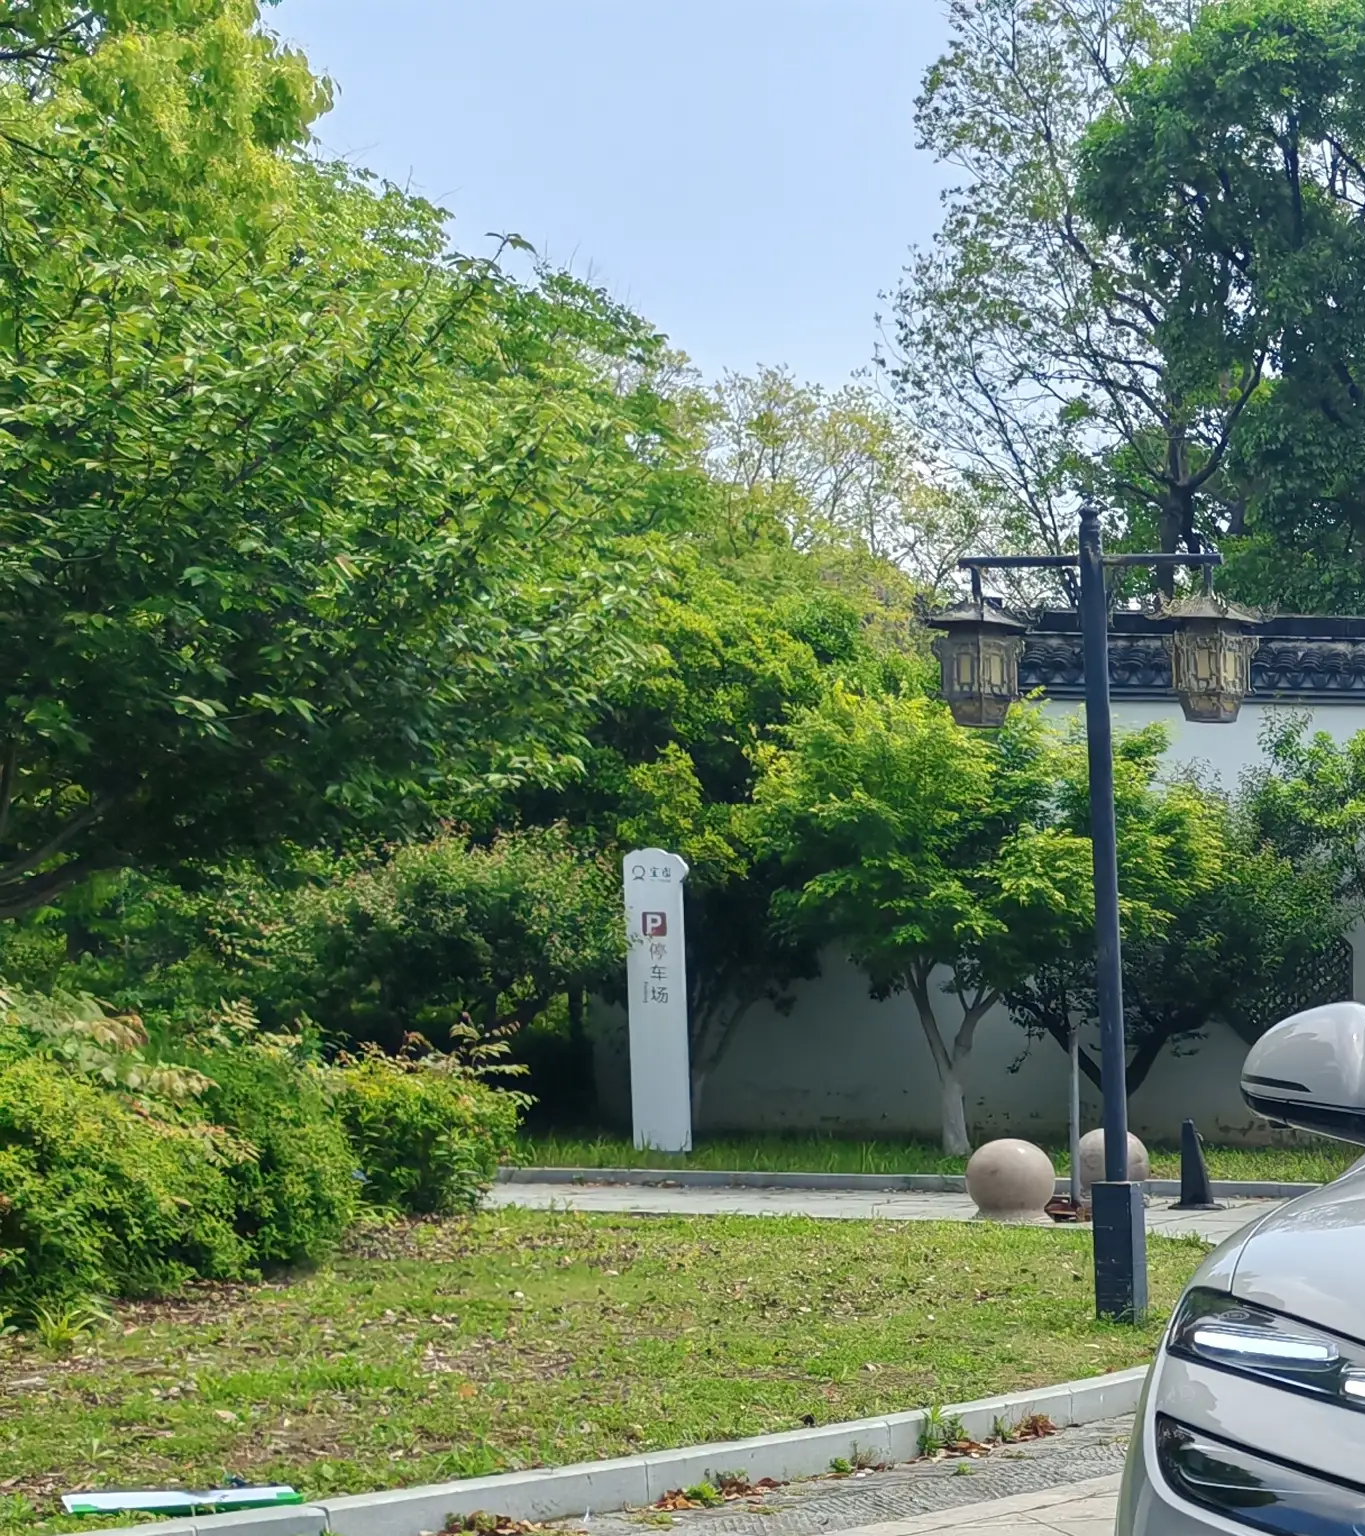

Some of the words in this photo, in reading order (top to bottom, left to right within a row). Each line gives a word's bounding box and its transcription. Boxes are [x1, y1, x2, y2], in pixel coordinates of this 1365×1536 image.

[646, 913, 662, 934] P
[649, 941, 669, 1004] 停车场
